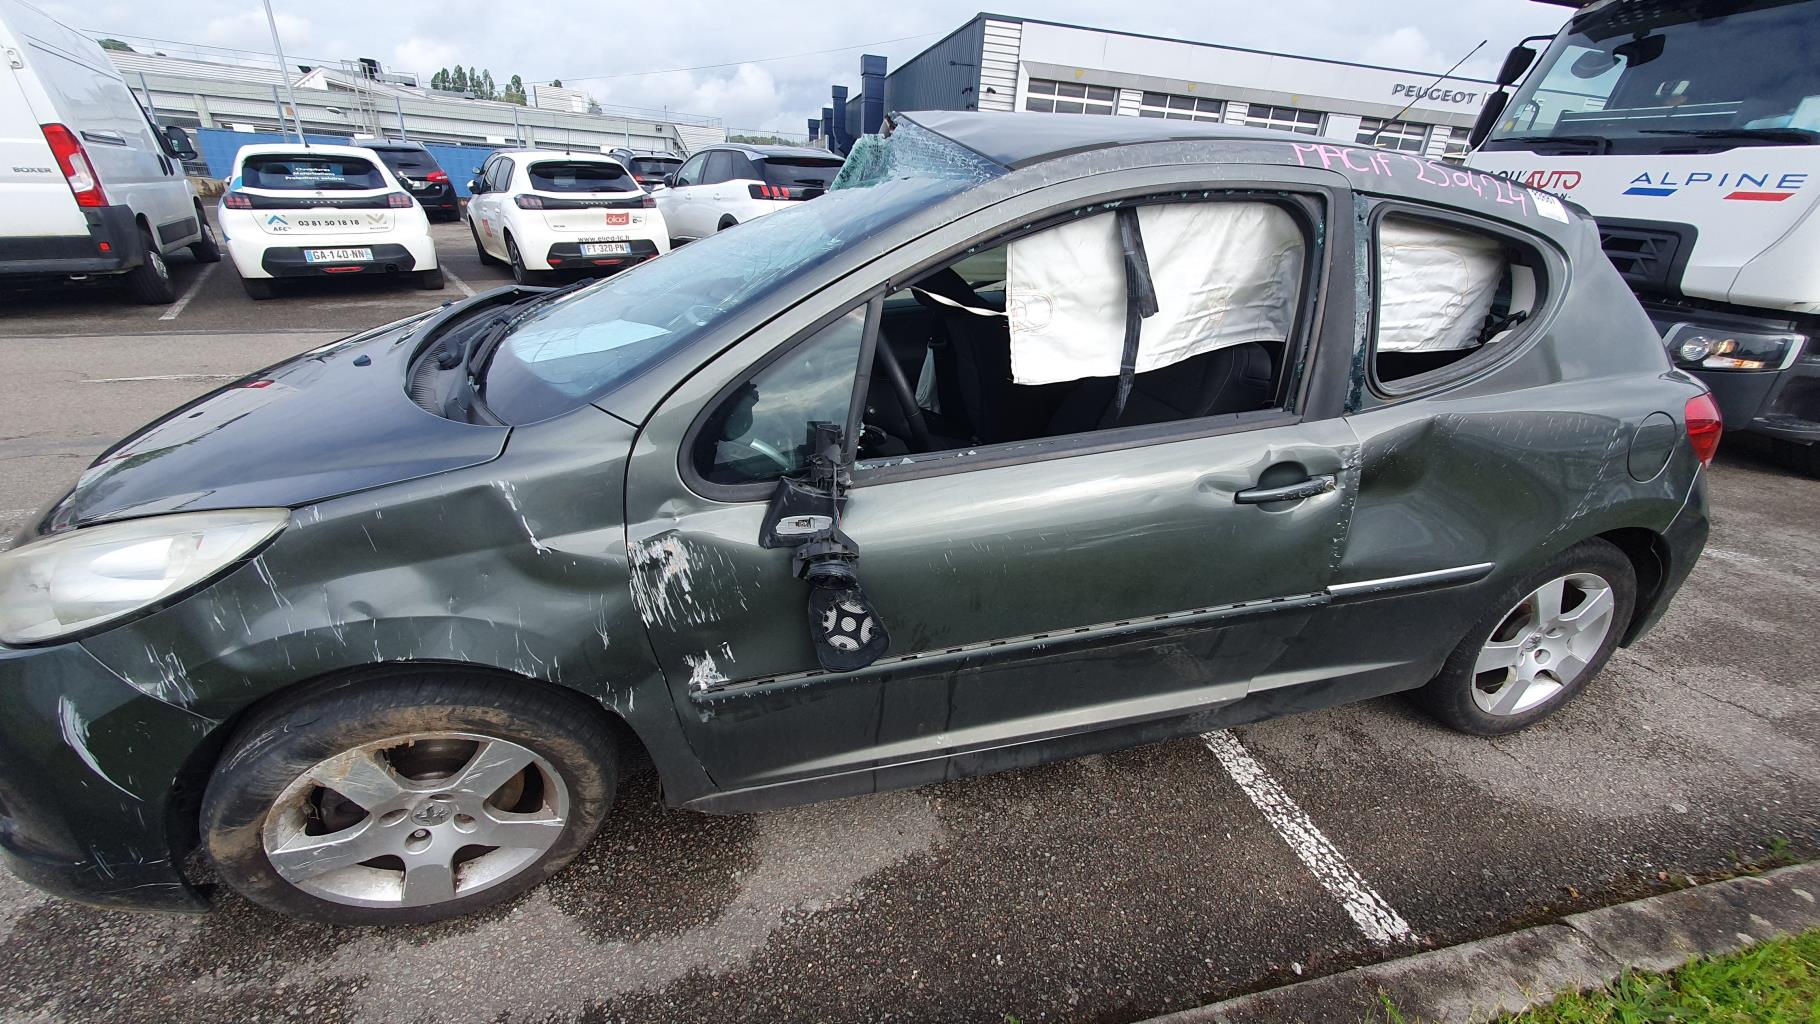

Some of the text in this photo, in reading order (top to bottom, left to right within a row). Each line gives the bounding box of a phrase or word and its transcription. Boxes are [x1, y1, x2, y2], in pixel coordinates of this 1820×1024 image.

[1392, 83, 1477, 104] PEUGEOT
[1401, 155, 1527, 216] 25.04.24
[1629, 171, 1808, 189] ALPINE
[312, 249, 365, 260] GA-140-NN
[586, 243, 625, 253] FT-320-PN
